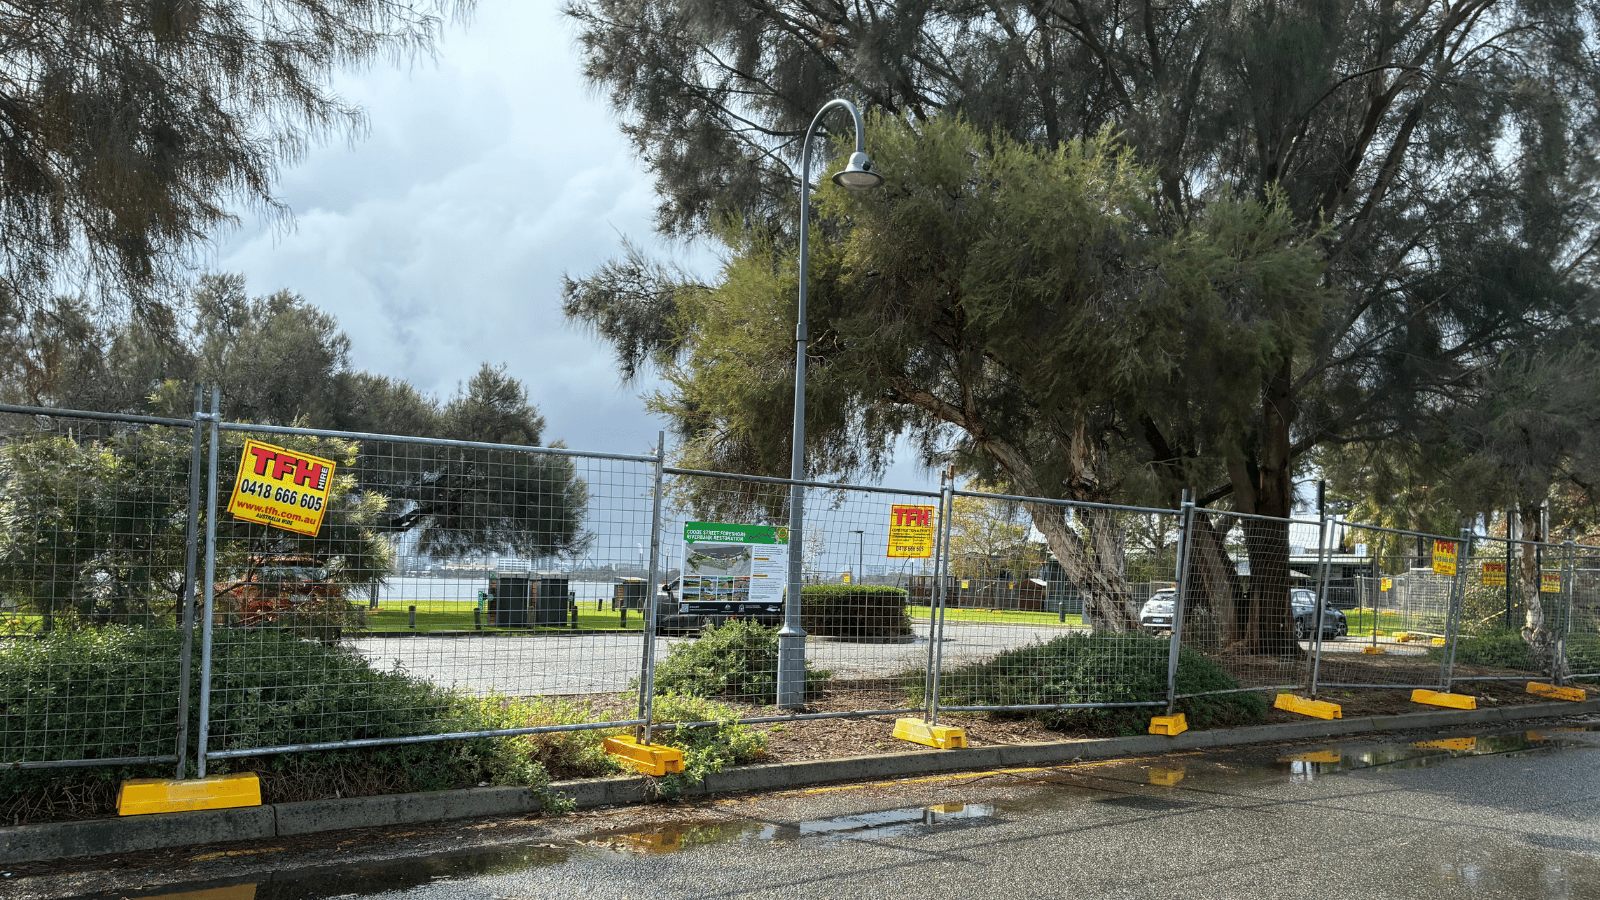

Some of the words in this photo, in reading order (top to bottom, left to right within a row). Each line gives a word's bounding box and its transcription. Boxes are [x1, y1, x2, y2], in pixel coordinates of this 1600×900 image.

[250, 446, 323, 490] TFH
[317, 466, 330, 491] HIRE
[240, 478, 272, 499] 0418
[274, 486, 298, 506] 666
[300, 493, 323, 512] 605
[236, 500, 317, 526] www.tfh.com.au
[255, 512, 281, 524] AUSTRALIA
[281, 517, 294, 526] WIDE
[894, 508, 928, 526] TFH
[1436, 539, 1455, 554] TFH
